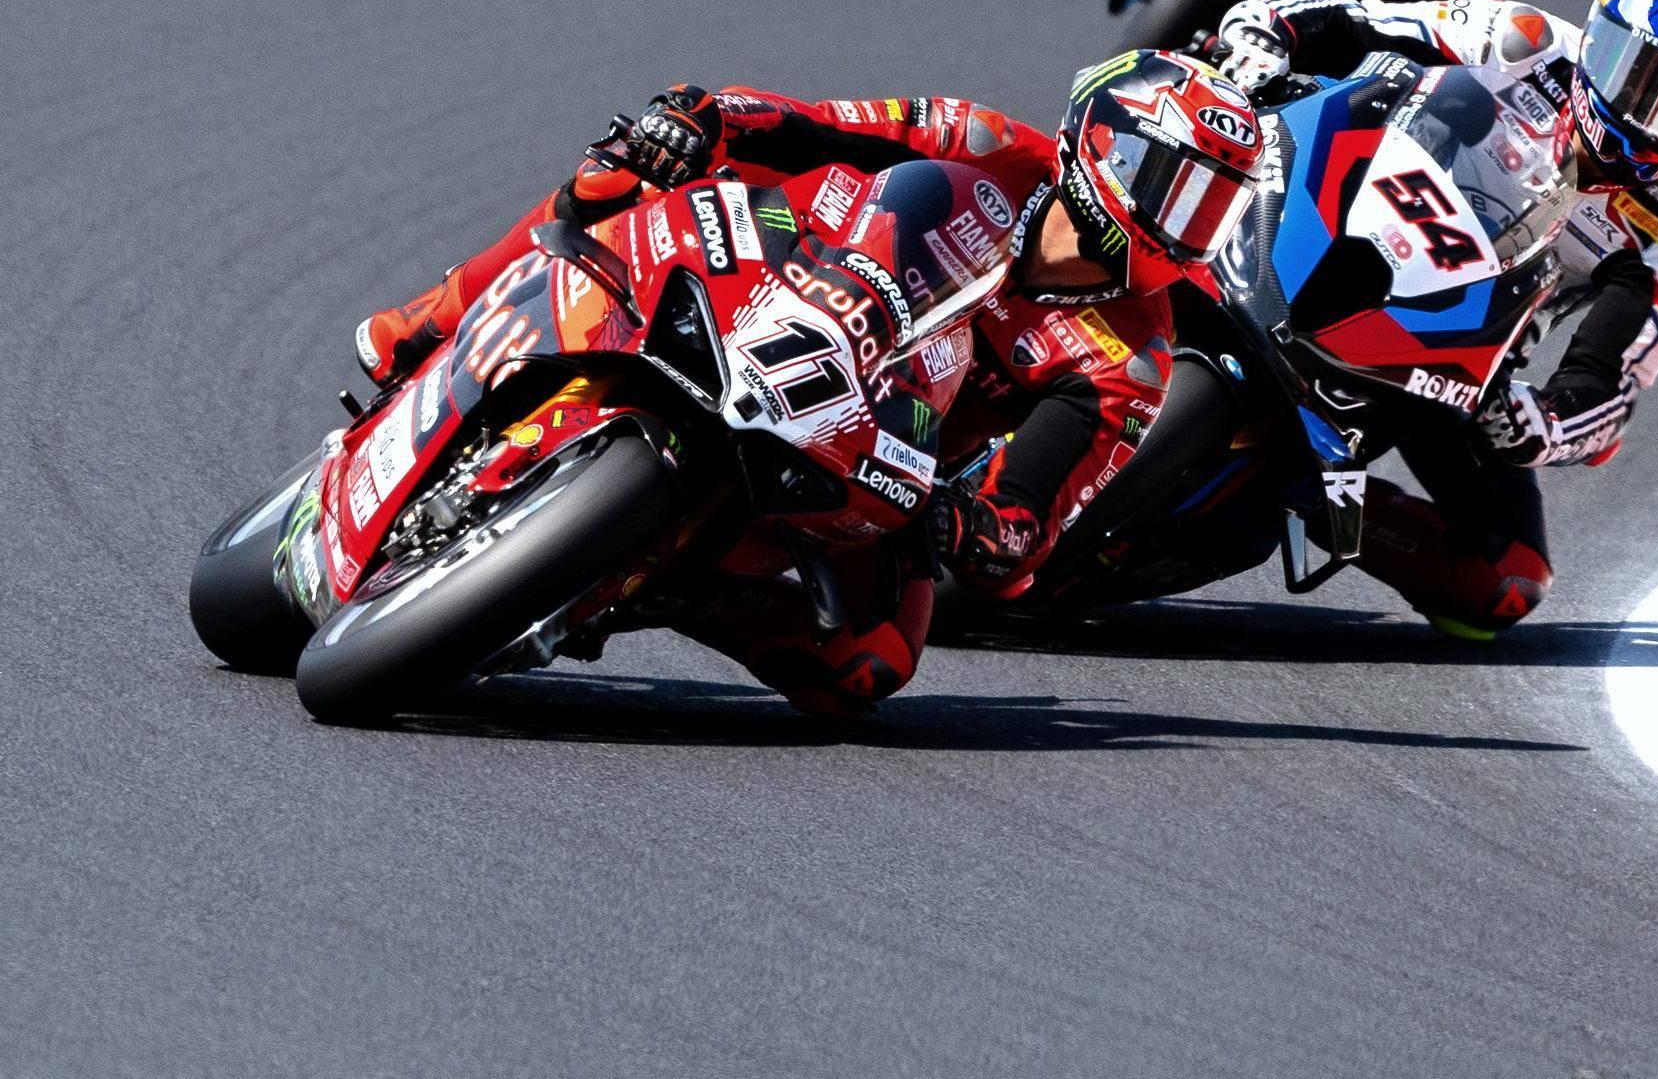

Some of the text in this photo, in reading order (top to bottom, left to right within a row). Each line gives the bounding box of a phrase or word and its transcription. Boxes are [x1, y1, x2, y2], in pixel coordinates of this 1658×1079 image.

[1136, 120, 1181, 150] CARRERA
[1198, 107, 1256, 144] KYT
[731, 198, 749, 233] riello
[975, 182, 1013, 224] KYT
[1008, 181, 1050, 259] DUCATI
[1071, 160, 1108, 229] MONSTER
[691, 190, 730, 270] Lenovo
[1371, 168, 1487, 273] 54
[930, 238, 971, 285] CARRERA
[845, 252, 913, 349] CARRERA
[737, 315, 858, 421] 11
[742, 364, 785, 422] WDW2024
[890, 443, 919, 470] riello
[857, 459, 918, 510] Lenovo
[1322, 470, 1367, 508] RR
